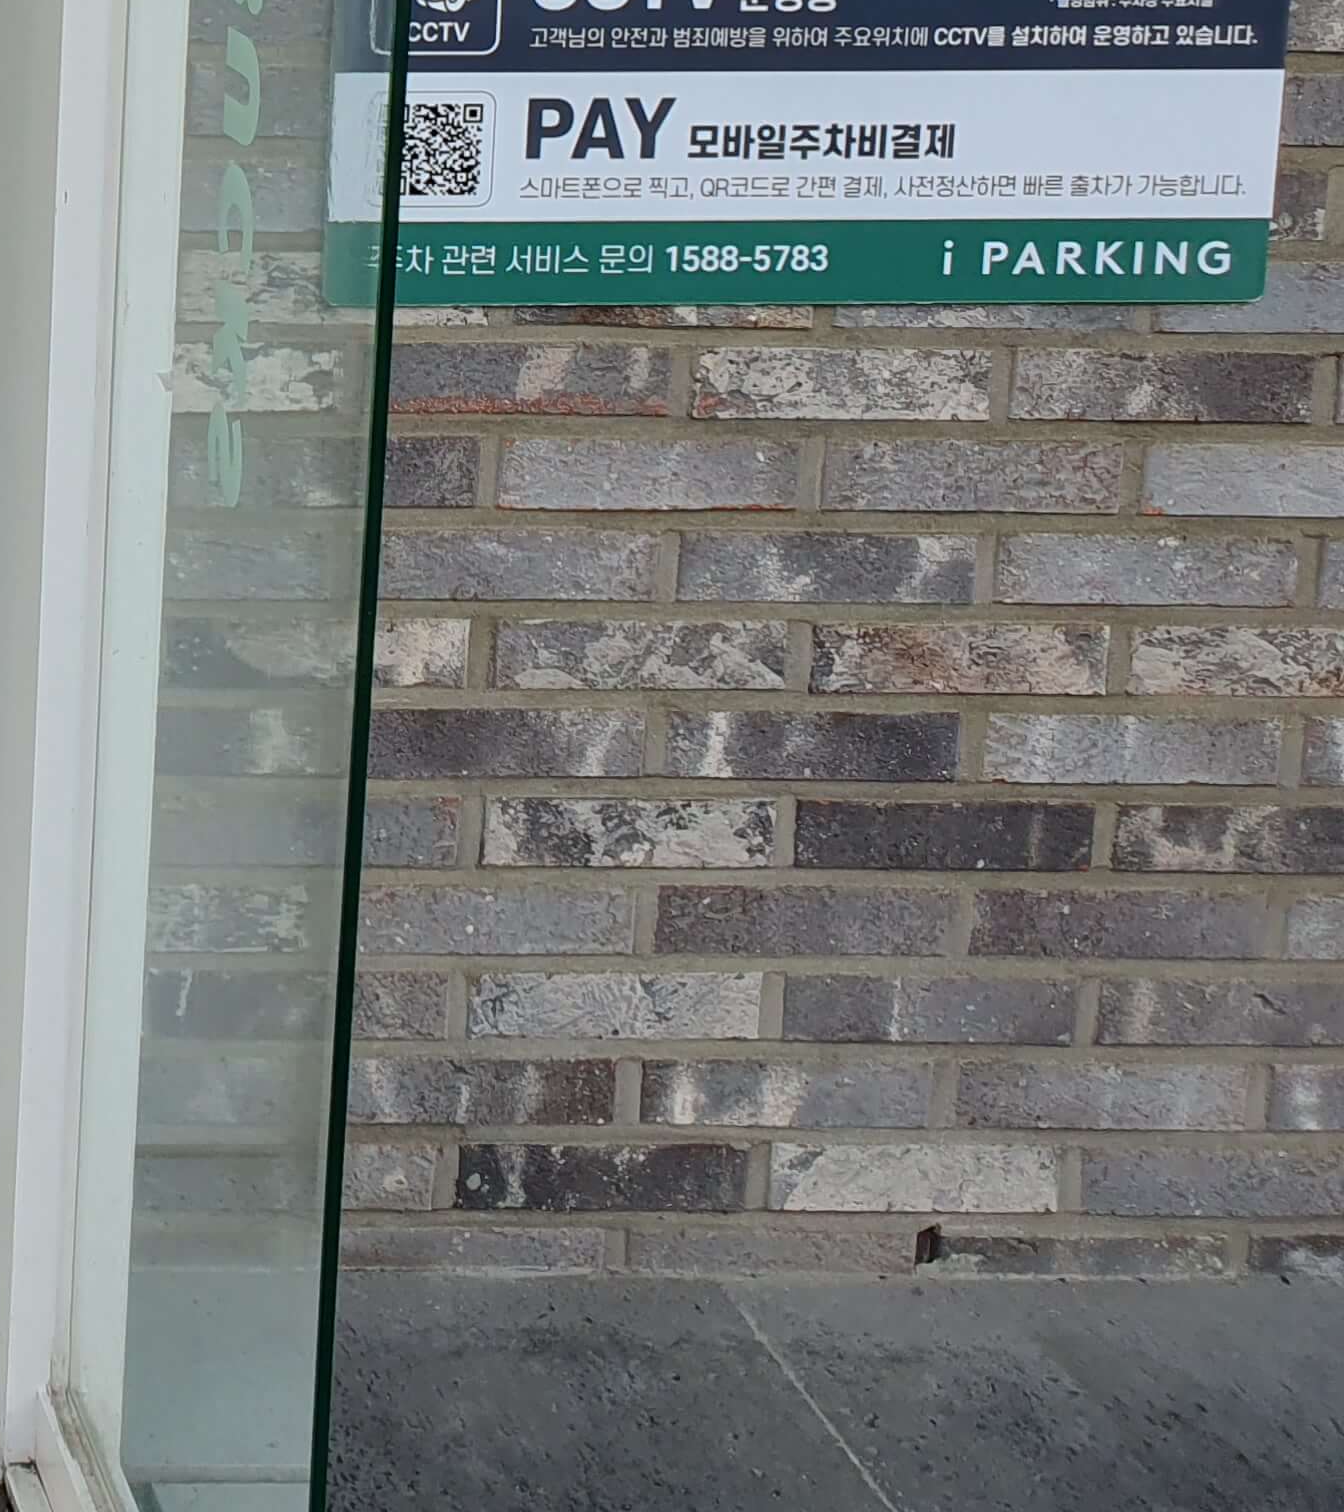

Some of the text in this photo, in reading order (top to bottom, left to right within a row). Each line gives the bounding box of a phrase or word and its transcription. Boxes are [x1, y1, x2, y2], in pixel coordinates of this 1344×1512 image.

[409, 22, 470, 42] CCTV
[530, 25, 1257, 48] 고객님의 안전과 범죄예방을 위하여 주요위치에 CCTV를 설치하여 운영하고 있습니다.
[526, 98, 955, 160] PAY 모바일주차비결제
[442, 246, 495, 274] 관련
[506, 245, 588, 273] 서비스
[599, 245, 653, 273] 문의
[666, 245, 828, 271] 1588-5783
[943, 240, 953, 275] i
[982, 241, 1231, 274] PARKING
